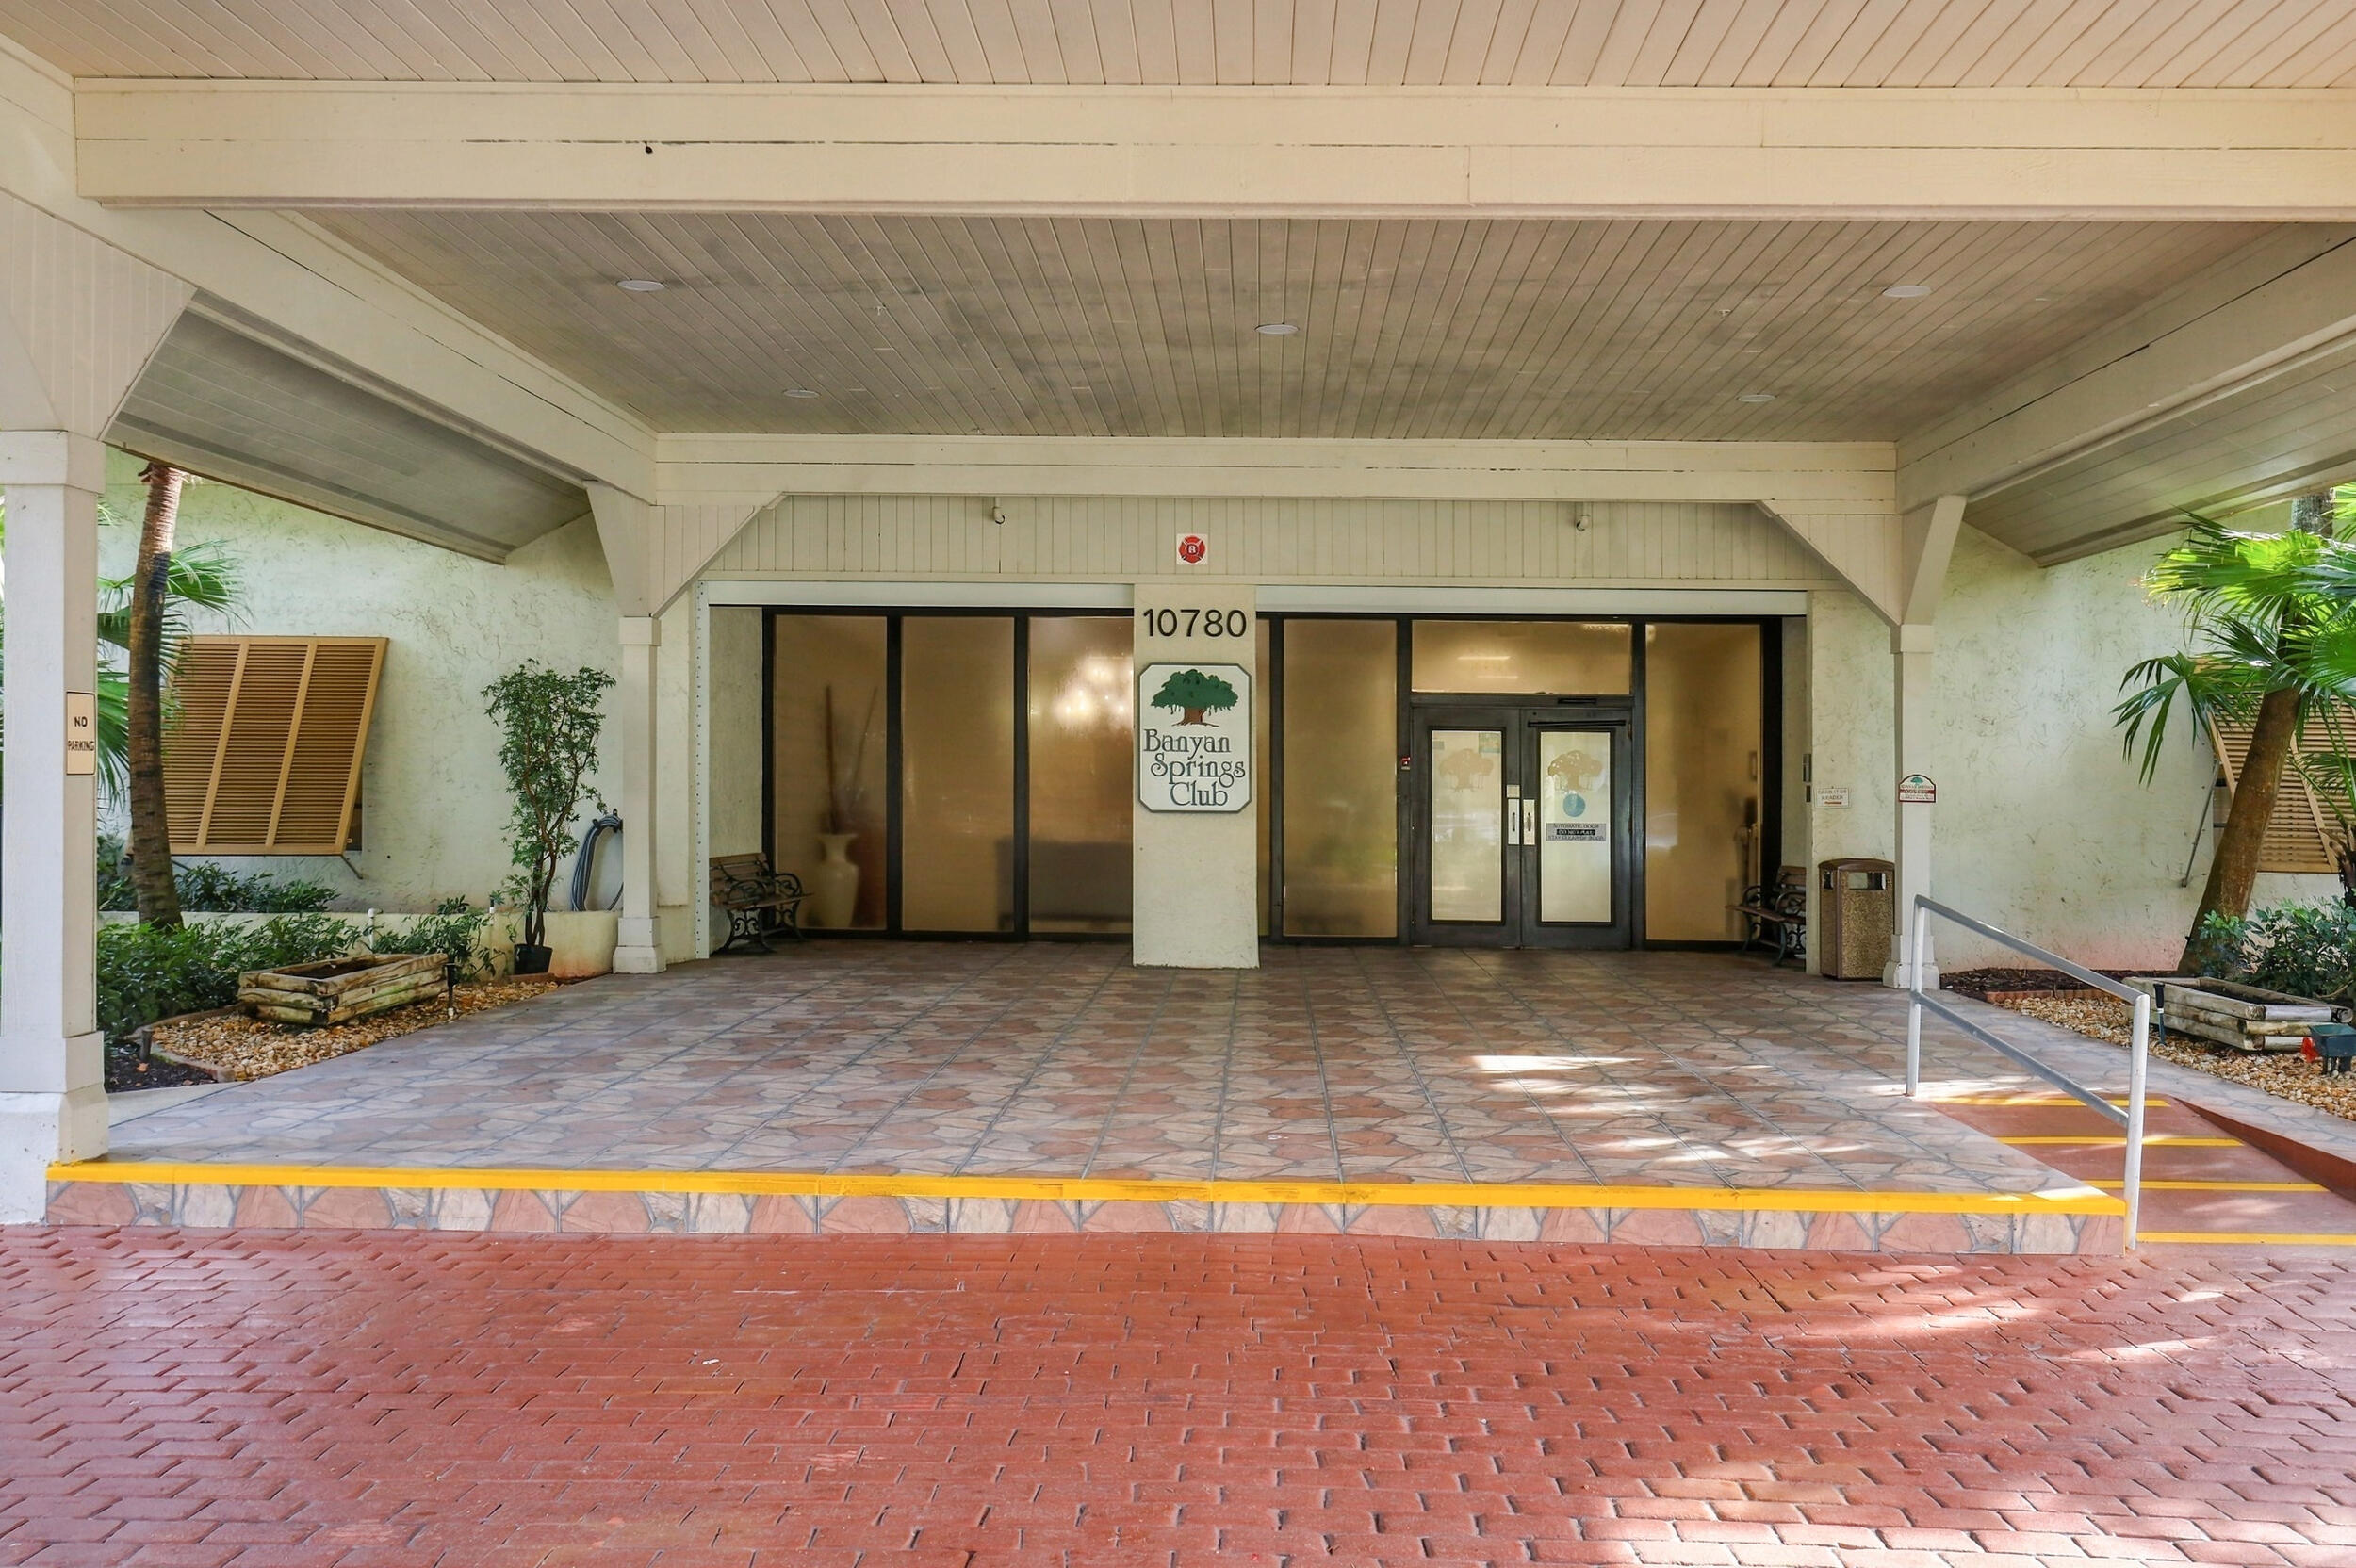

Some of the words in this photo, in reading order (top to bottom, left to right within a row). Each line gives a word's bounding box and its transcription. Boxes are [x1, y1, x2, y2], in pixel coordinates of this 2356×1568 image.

[1143, 608, 1247, 637] 10780
[74, 716, 88, 727] NO
[67, 740, 94, 752] PARKING
[1143, 728, 1231, 760] Banyan
[1150, 752, 1246, 788] Springs
[1170, 780, 1229, 807] Club
